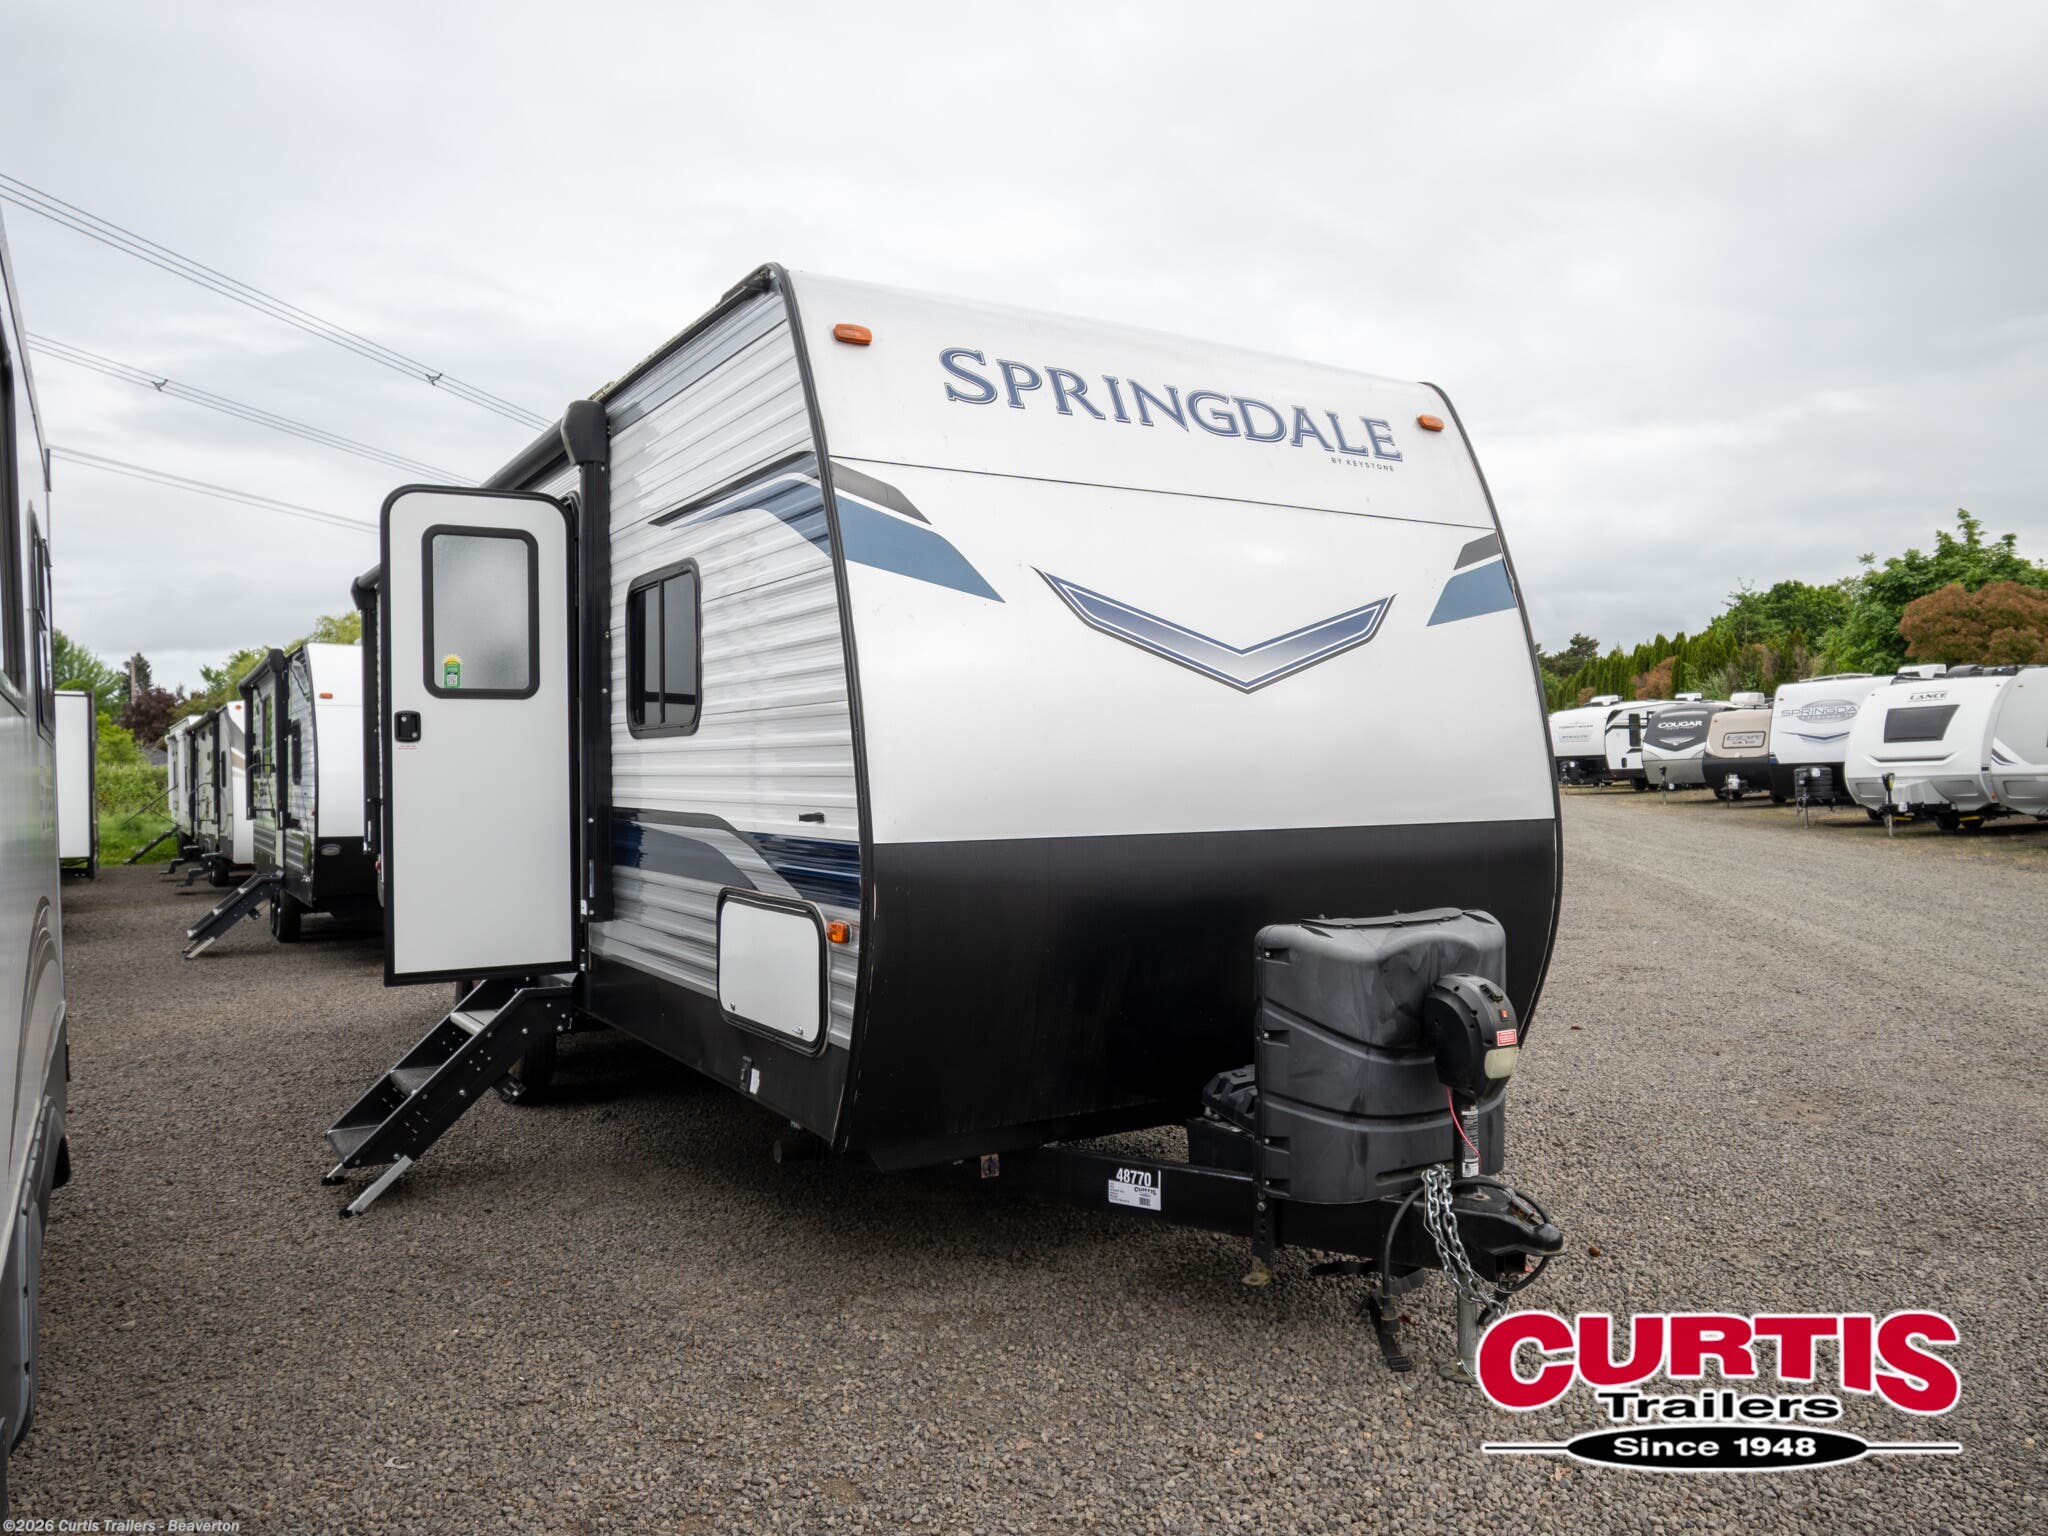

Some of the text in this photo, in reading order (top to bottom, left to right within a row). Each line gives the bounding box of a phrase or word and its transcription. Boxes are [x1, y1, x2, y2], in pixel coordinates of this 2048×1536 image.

[938, 346, 1403, 462] SPRINGDALE
[1330, 457, 1395, 472] BY KEYSTONE
[1780, 704, 1858, 718] SPRINGDA
[1657, 719, 1703, 729] COUGAR
[1116, 1168, 1151, 1187] 48770
